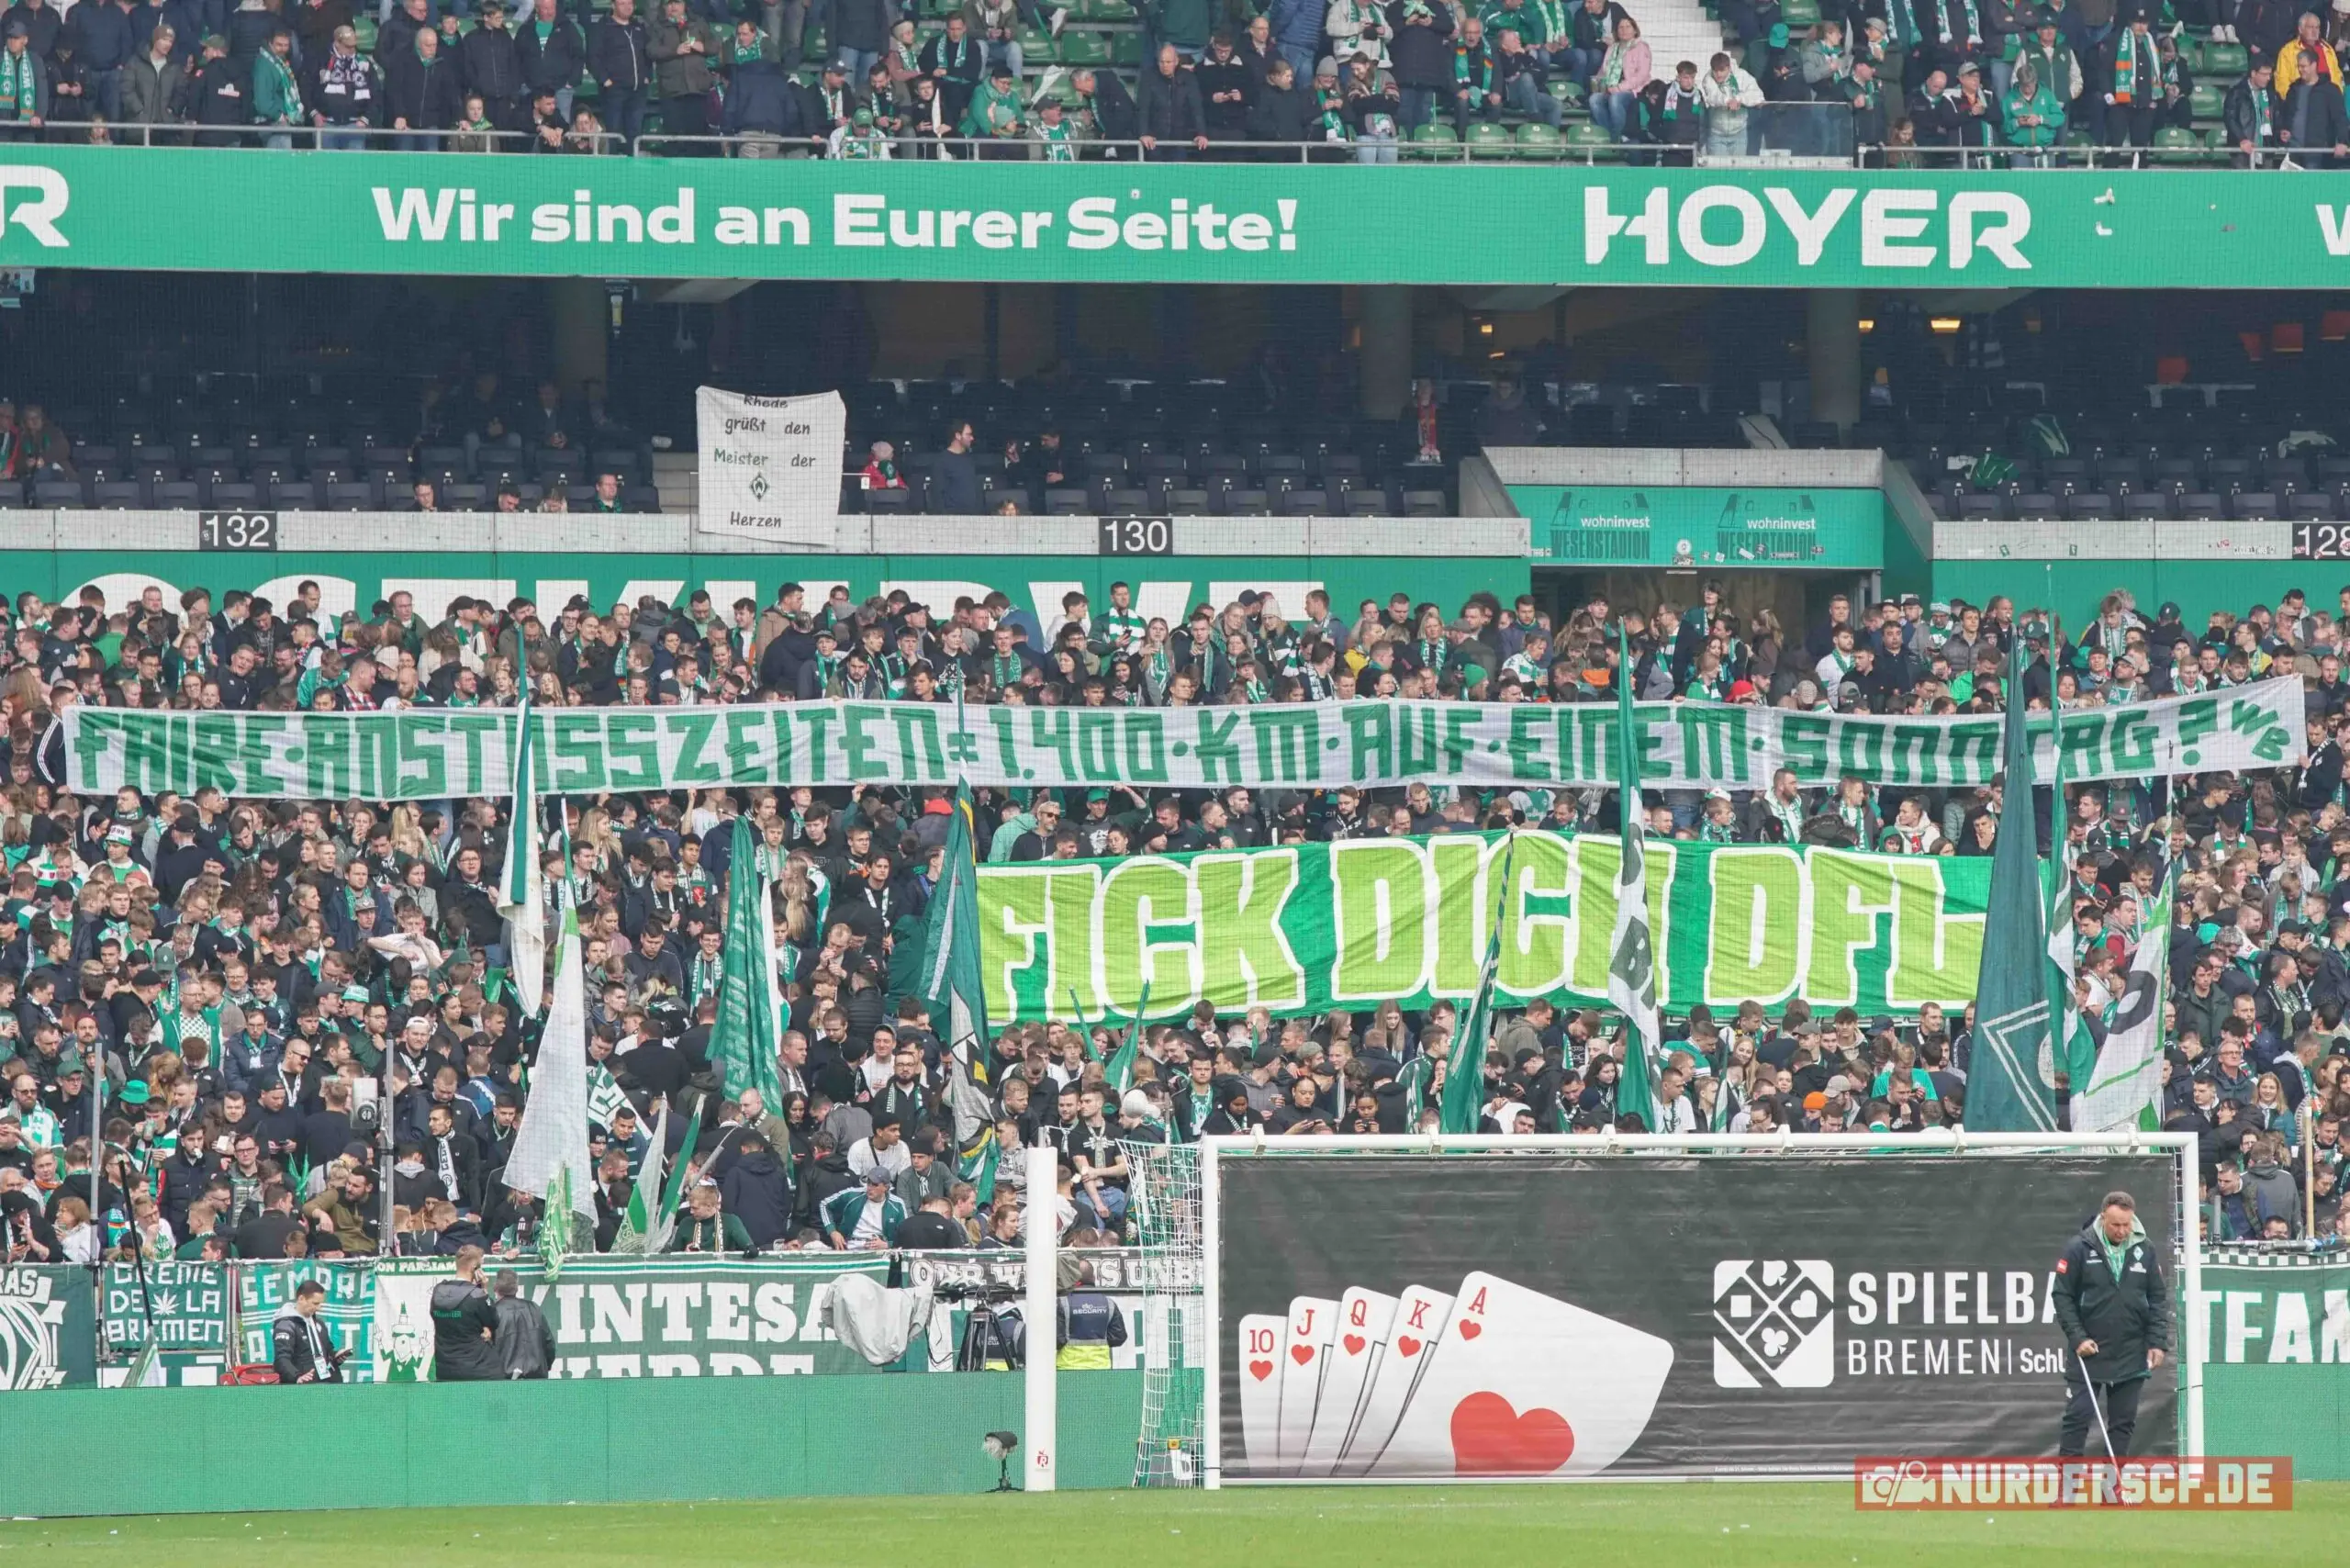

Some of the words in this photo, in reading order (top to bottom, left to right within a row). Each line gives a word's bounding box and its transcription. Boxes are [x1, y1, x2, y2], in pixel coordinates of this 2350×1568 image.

[372, 187, 513, 242] Wir
[531, 186, 695, 244] sind
[714, 207, 811, 247] an
[834, 193, 1054, 250] Eurer
[1067, 196, 1298, 252] Seite!
[1584, 185, 2032, 269] HOYER
[744, 395, 789, 409] Rhede
[724, 417, 767, 435] grüßt
[784, 421, 811, 435] den
[714, 447, 769, 466] Meister
[790, 454, 816, 467] der
[206, 515, 270, 547] 132
[730, 511, 782, 528] Herzen
[1580, 514, 1651, 528] wohninvest
[1746, 516, 1817, 530] wohninvest
[1104, 520, 1169, 553] 130
[1550, 529, 1651, 560] WESERSTADION
[73, 711, 284, 795] FAIRE
[988, 708, 1169, 784] 1.400
[1195, 709, 1321, 784] KM
[1342, 701, 1486, 781] AUF
[1507, 706, 1749, 782] EINEM
[977, 846, 1306, 1023] FICK
[1330, 830, 1677, 1007] DICH
[1703, 845, 1986, 1011] DFL
[110, 1289, 144, 1314] DE
[185, 1289, 221, 1314] LA
[1248, 1328, 1274, 1353] 10
[1848, 1338, 1999, 1375] BREMEN
